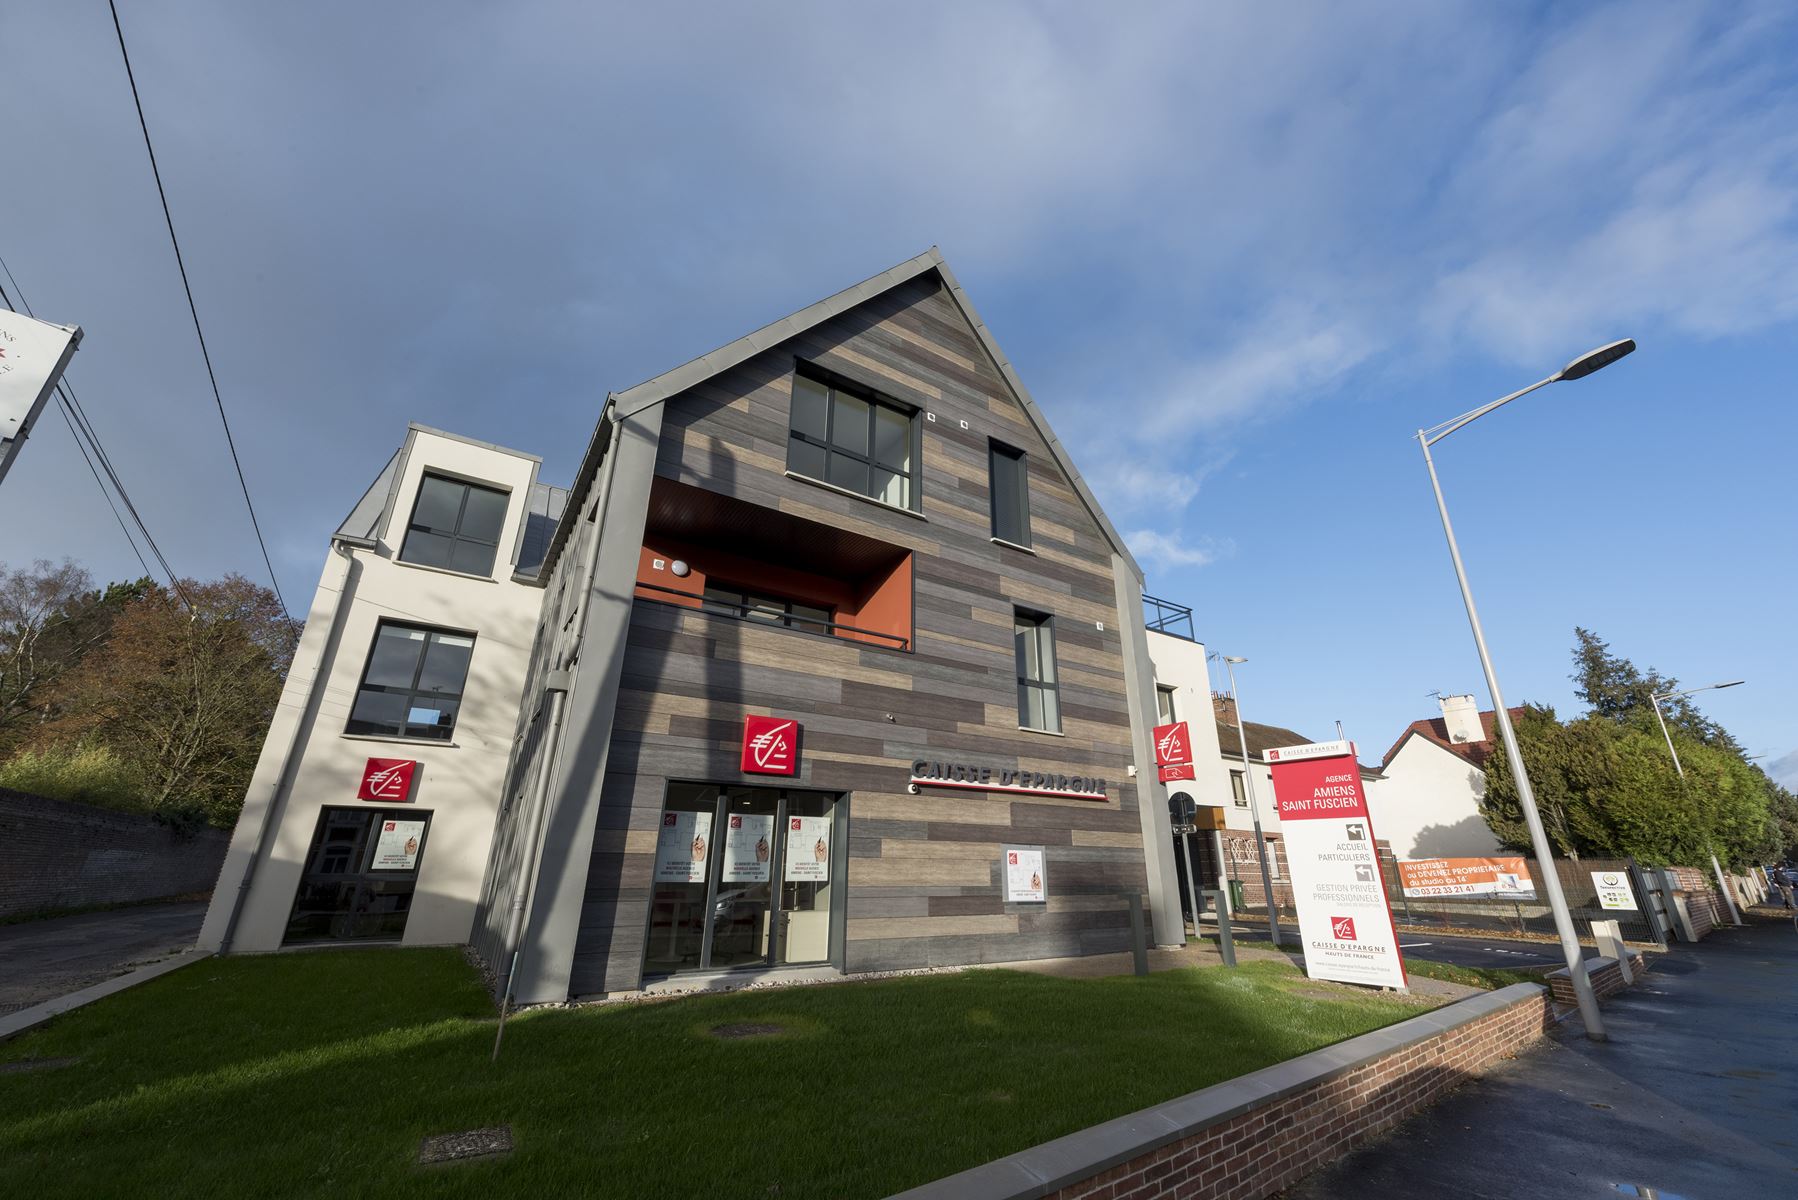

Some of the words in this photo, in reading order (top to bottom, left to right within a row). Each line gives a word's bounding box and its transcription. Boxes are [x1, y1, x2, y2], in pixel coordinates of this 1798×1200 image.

[911, 759, 991, 783] CAISSE
[1000, 768, 1106, 793] D'EPARGNE
[1325, 774, 1353, 783] AGENCE
[1314, 785, 1356, 797] AMIENS
[1282, 799, 1312, 812] SAINT
[1313, 797, 1358, 809] FUSCIEN
[1336, 843, 1368, 851] ACCUEIL
[1318, 853, 1371, 861] PARTICULIERS
[1404, 861, 1449, 871] INVESTISSEZ
[1417, 869, 1451, 878] DEVENEZ
[1316, 883, 1349, 892] GESTION
[1443, 886, 1453, 894] 33
[1465, 885, 1475, 893] 41
[1313, 893, 1380, 902] PROFESSIONNELS
[1312, 941, 1338, 949] CAISSE
[1340, 943, 1386, 953] D'EPARGNE
